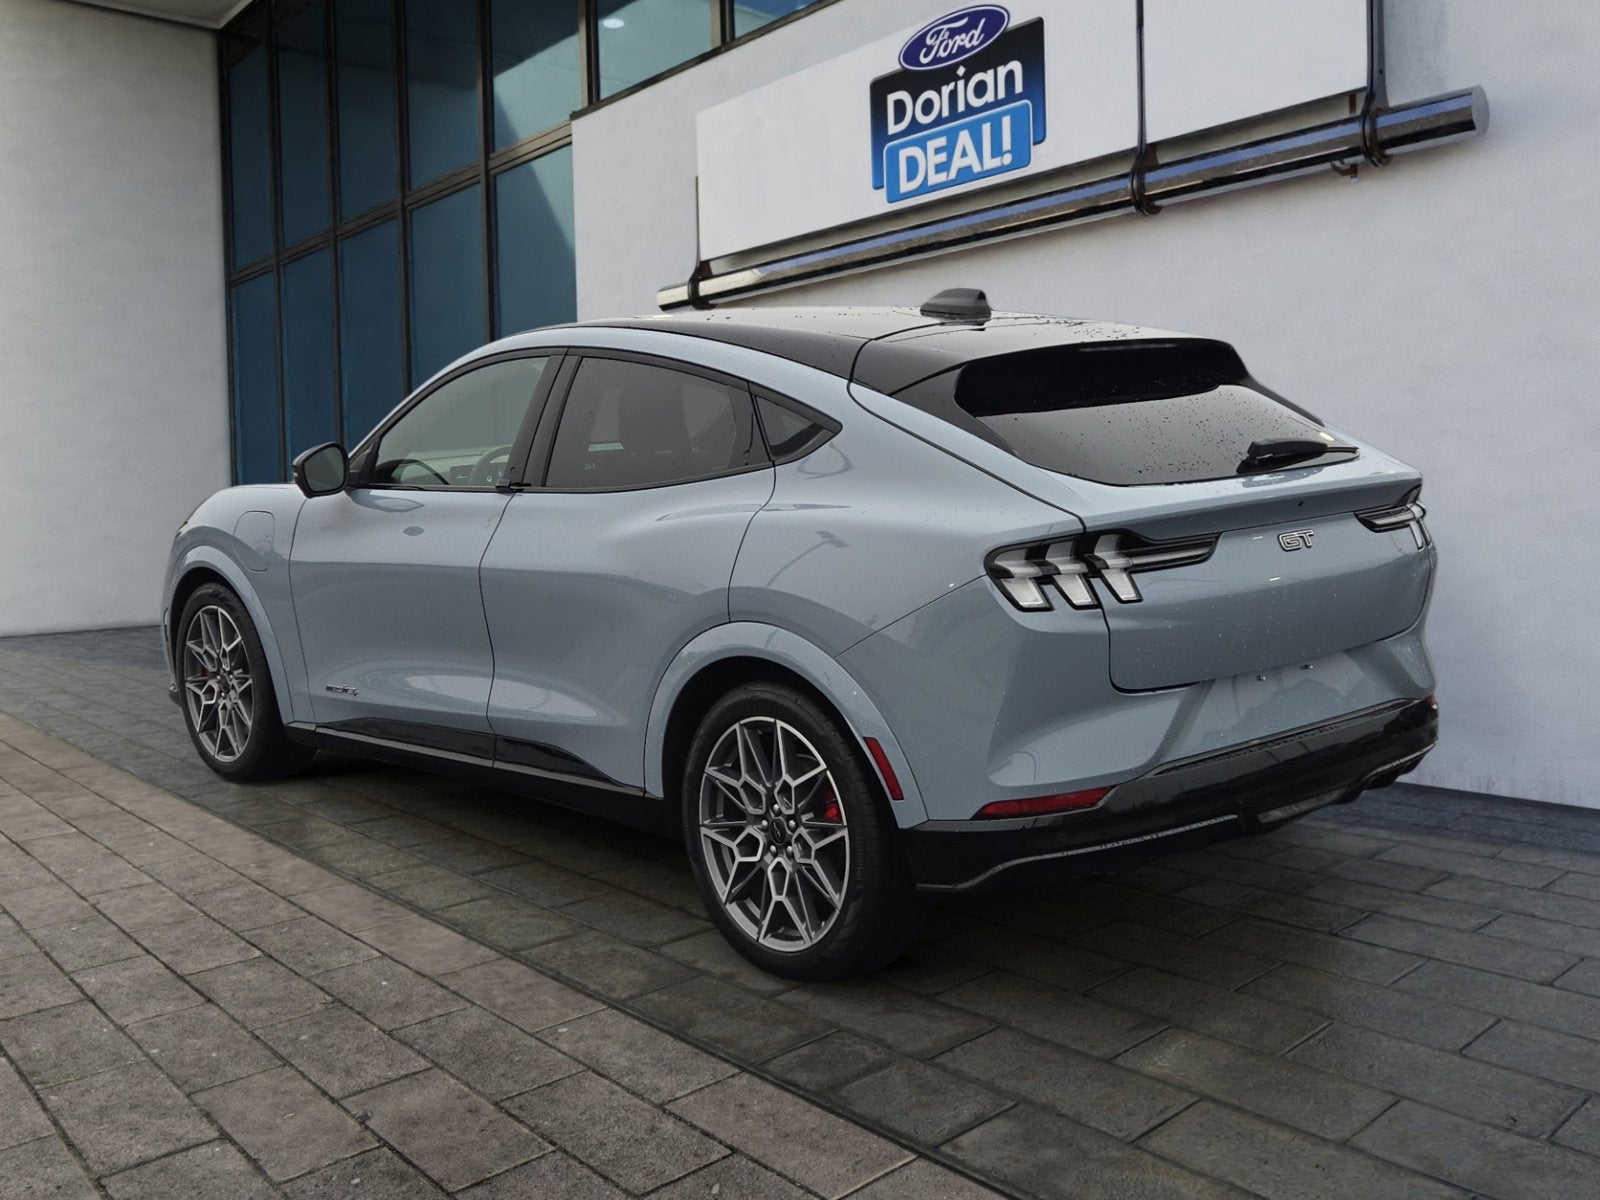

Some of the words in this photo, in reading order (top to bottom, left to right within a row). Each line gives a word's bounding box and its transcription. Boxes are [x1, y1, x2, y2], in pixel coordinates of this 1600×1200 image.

[919, 16, 986, 64] Ford
[886, 60, 1023, 135] Dorian
[899, 114, 1013, 194] DEAL!
[1278, 529, 1314, 551] GT
